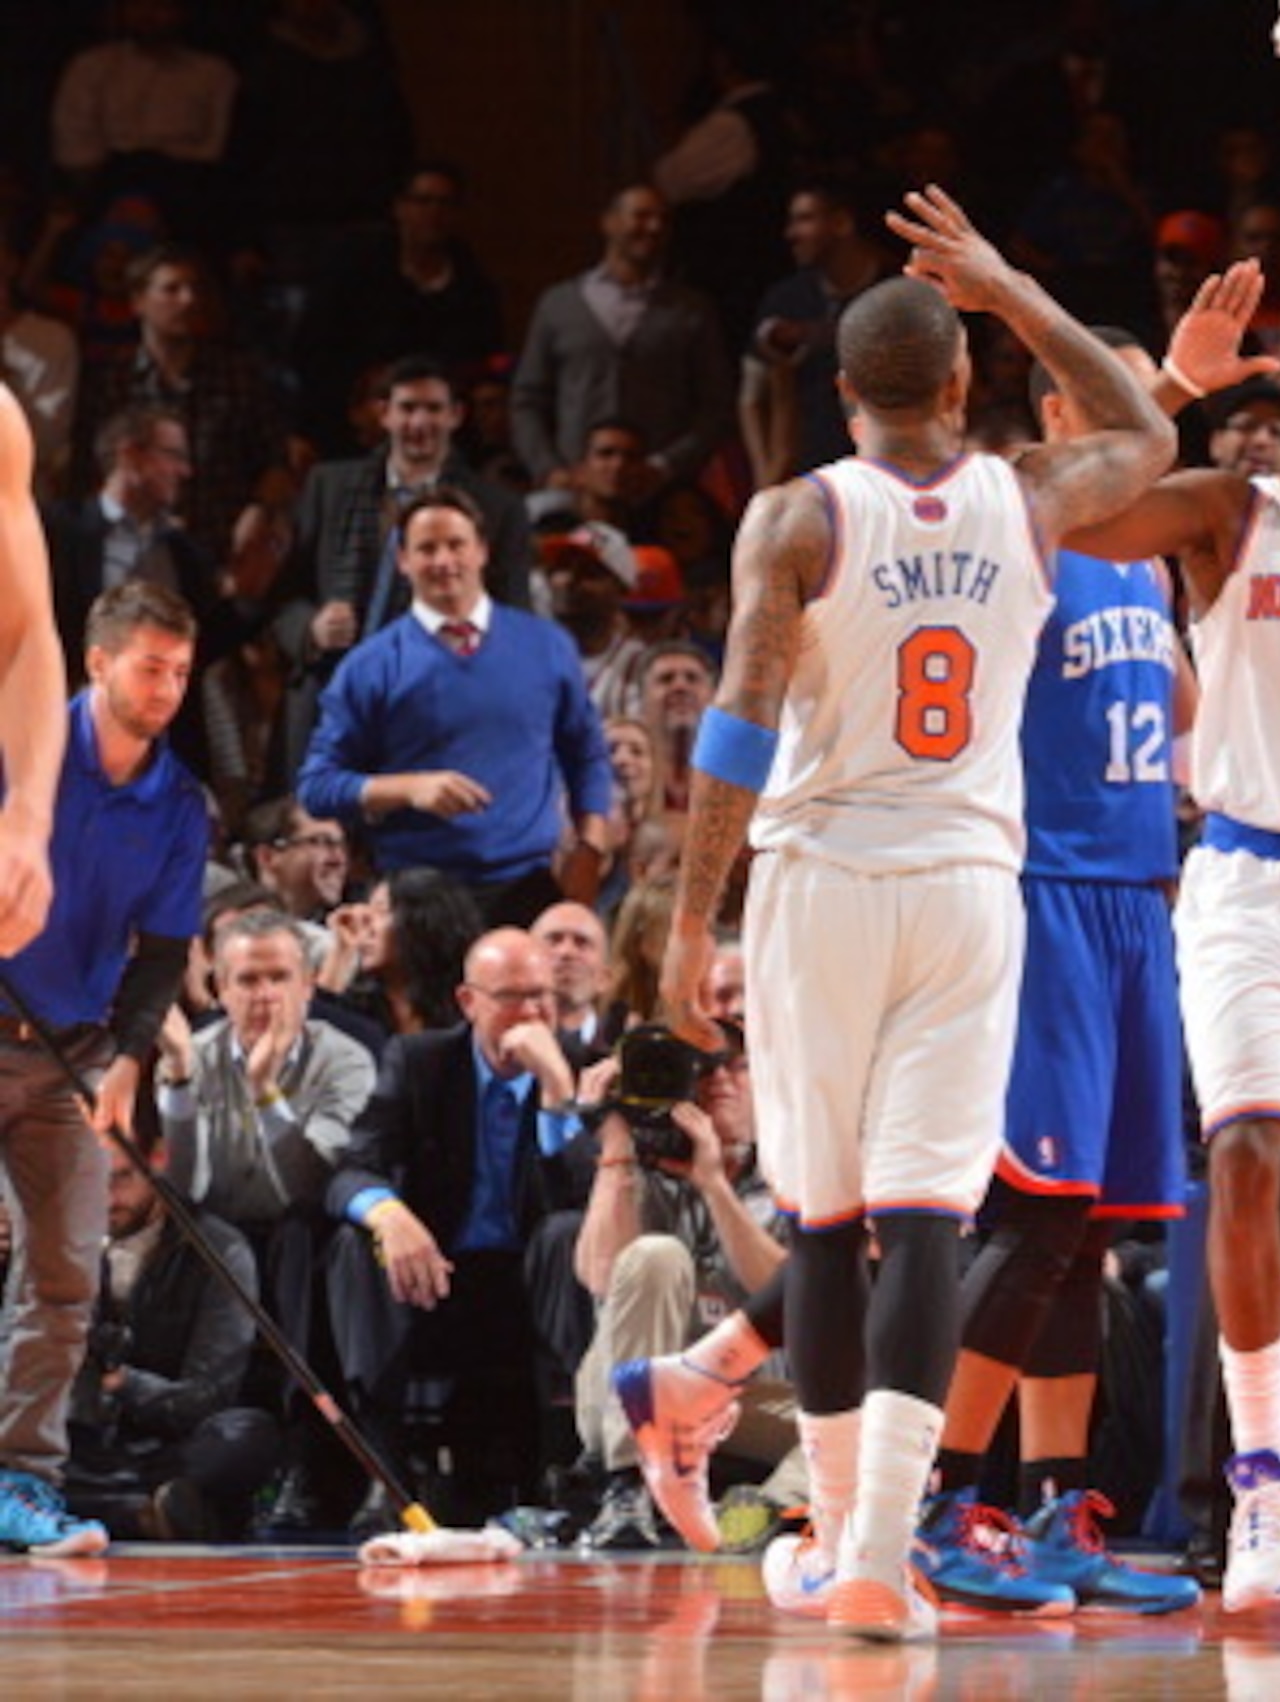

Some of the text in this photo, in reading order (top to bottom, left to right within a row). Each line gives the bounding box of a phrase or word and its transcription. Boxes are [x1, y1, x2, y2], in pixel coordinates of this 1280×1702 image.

[872, 551, 1000, 608] SMITH
[894, 624, 978, 763] 8
[1105, 701, 1169, 783] 12
